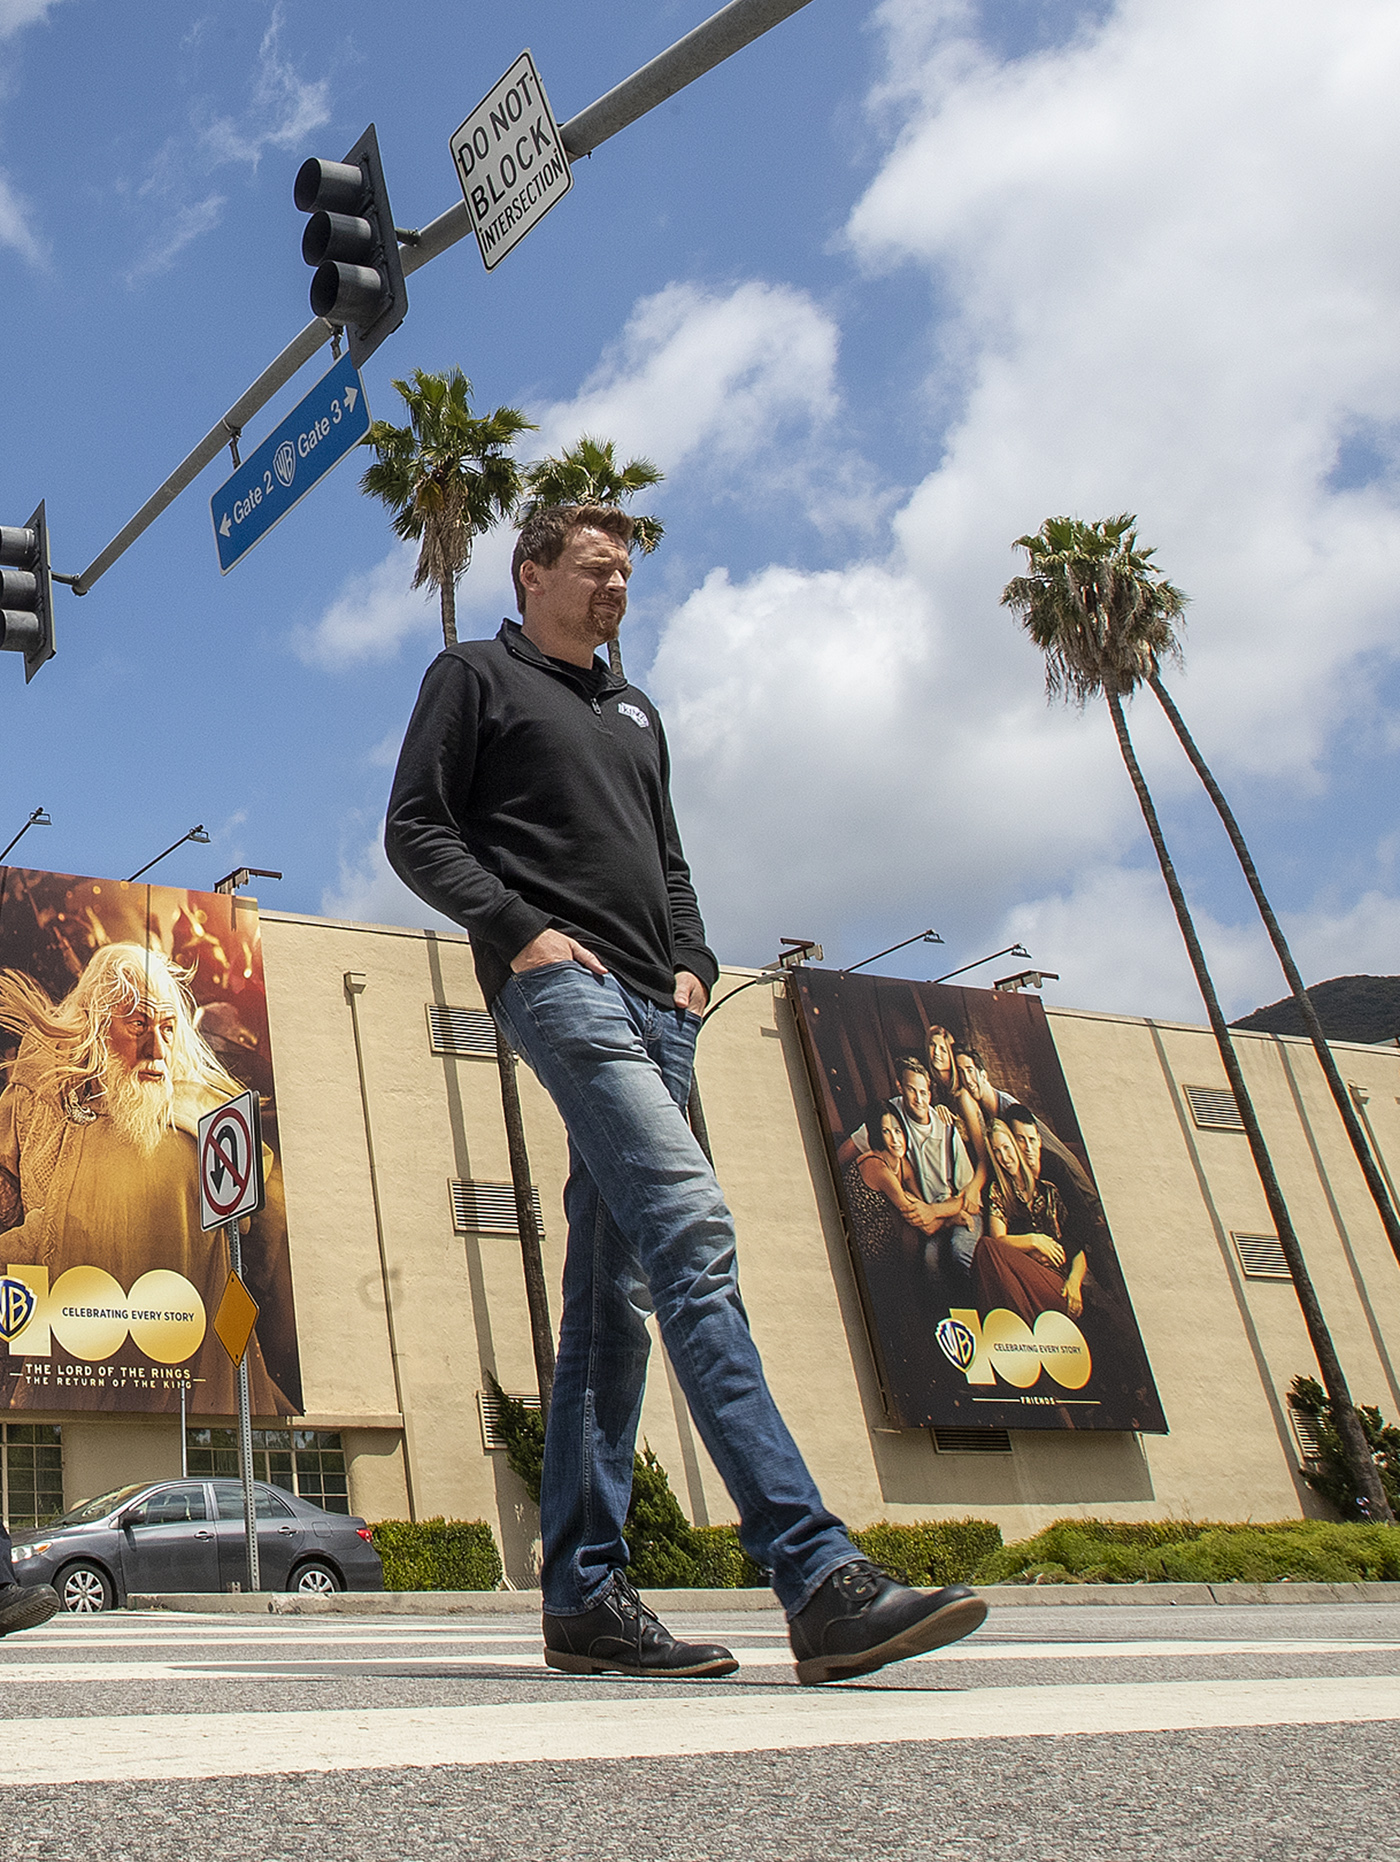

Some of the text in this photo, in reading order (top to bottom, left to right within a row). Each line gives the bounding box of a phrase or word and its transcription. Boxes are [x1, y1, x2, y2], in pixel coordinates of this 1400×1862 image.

[458, 72, 533, 177] DO NOT
[471, 116, 552, 221] BLOCK
[481, 153, 564, 253] INTERSECTION
[233, 486, 263, 525] Gate
[263, 470, 274, 495] 2
[297, 417, 330, 458] Gate
[330, 400, 342, 424] 3
[7, 1264, 207, 1364] 100
[61, 1306, 195, 1322] CELEBRATING EVERY STORY
[25, 1363, 191, 1379] THE LORD OF THE RINGS
[993, 1343, 1082, 1354] CELEBRATING EVERY STORY
[25, 1376, 49, 1385] THE
[56, 1377, 105, 1387] RETURN
[112, 1379, 126, 1388] OF
[134, 1380, 156, 1389] THE
[1020, 1396, 1056, 1405] FRIENDS
